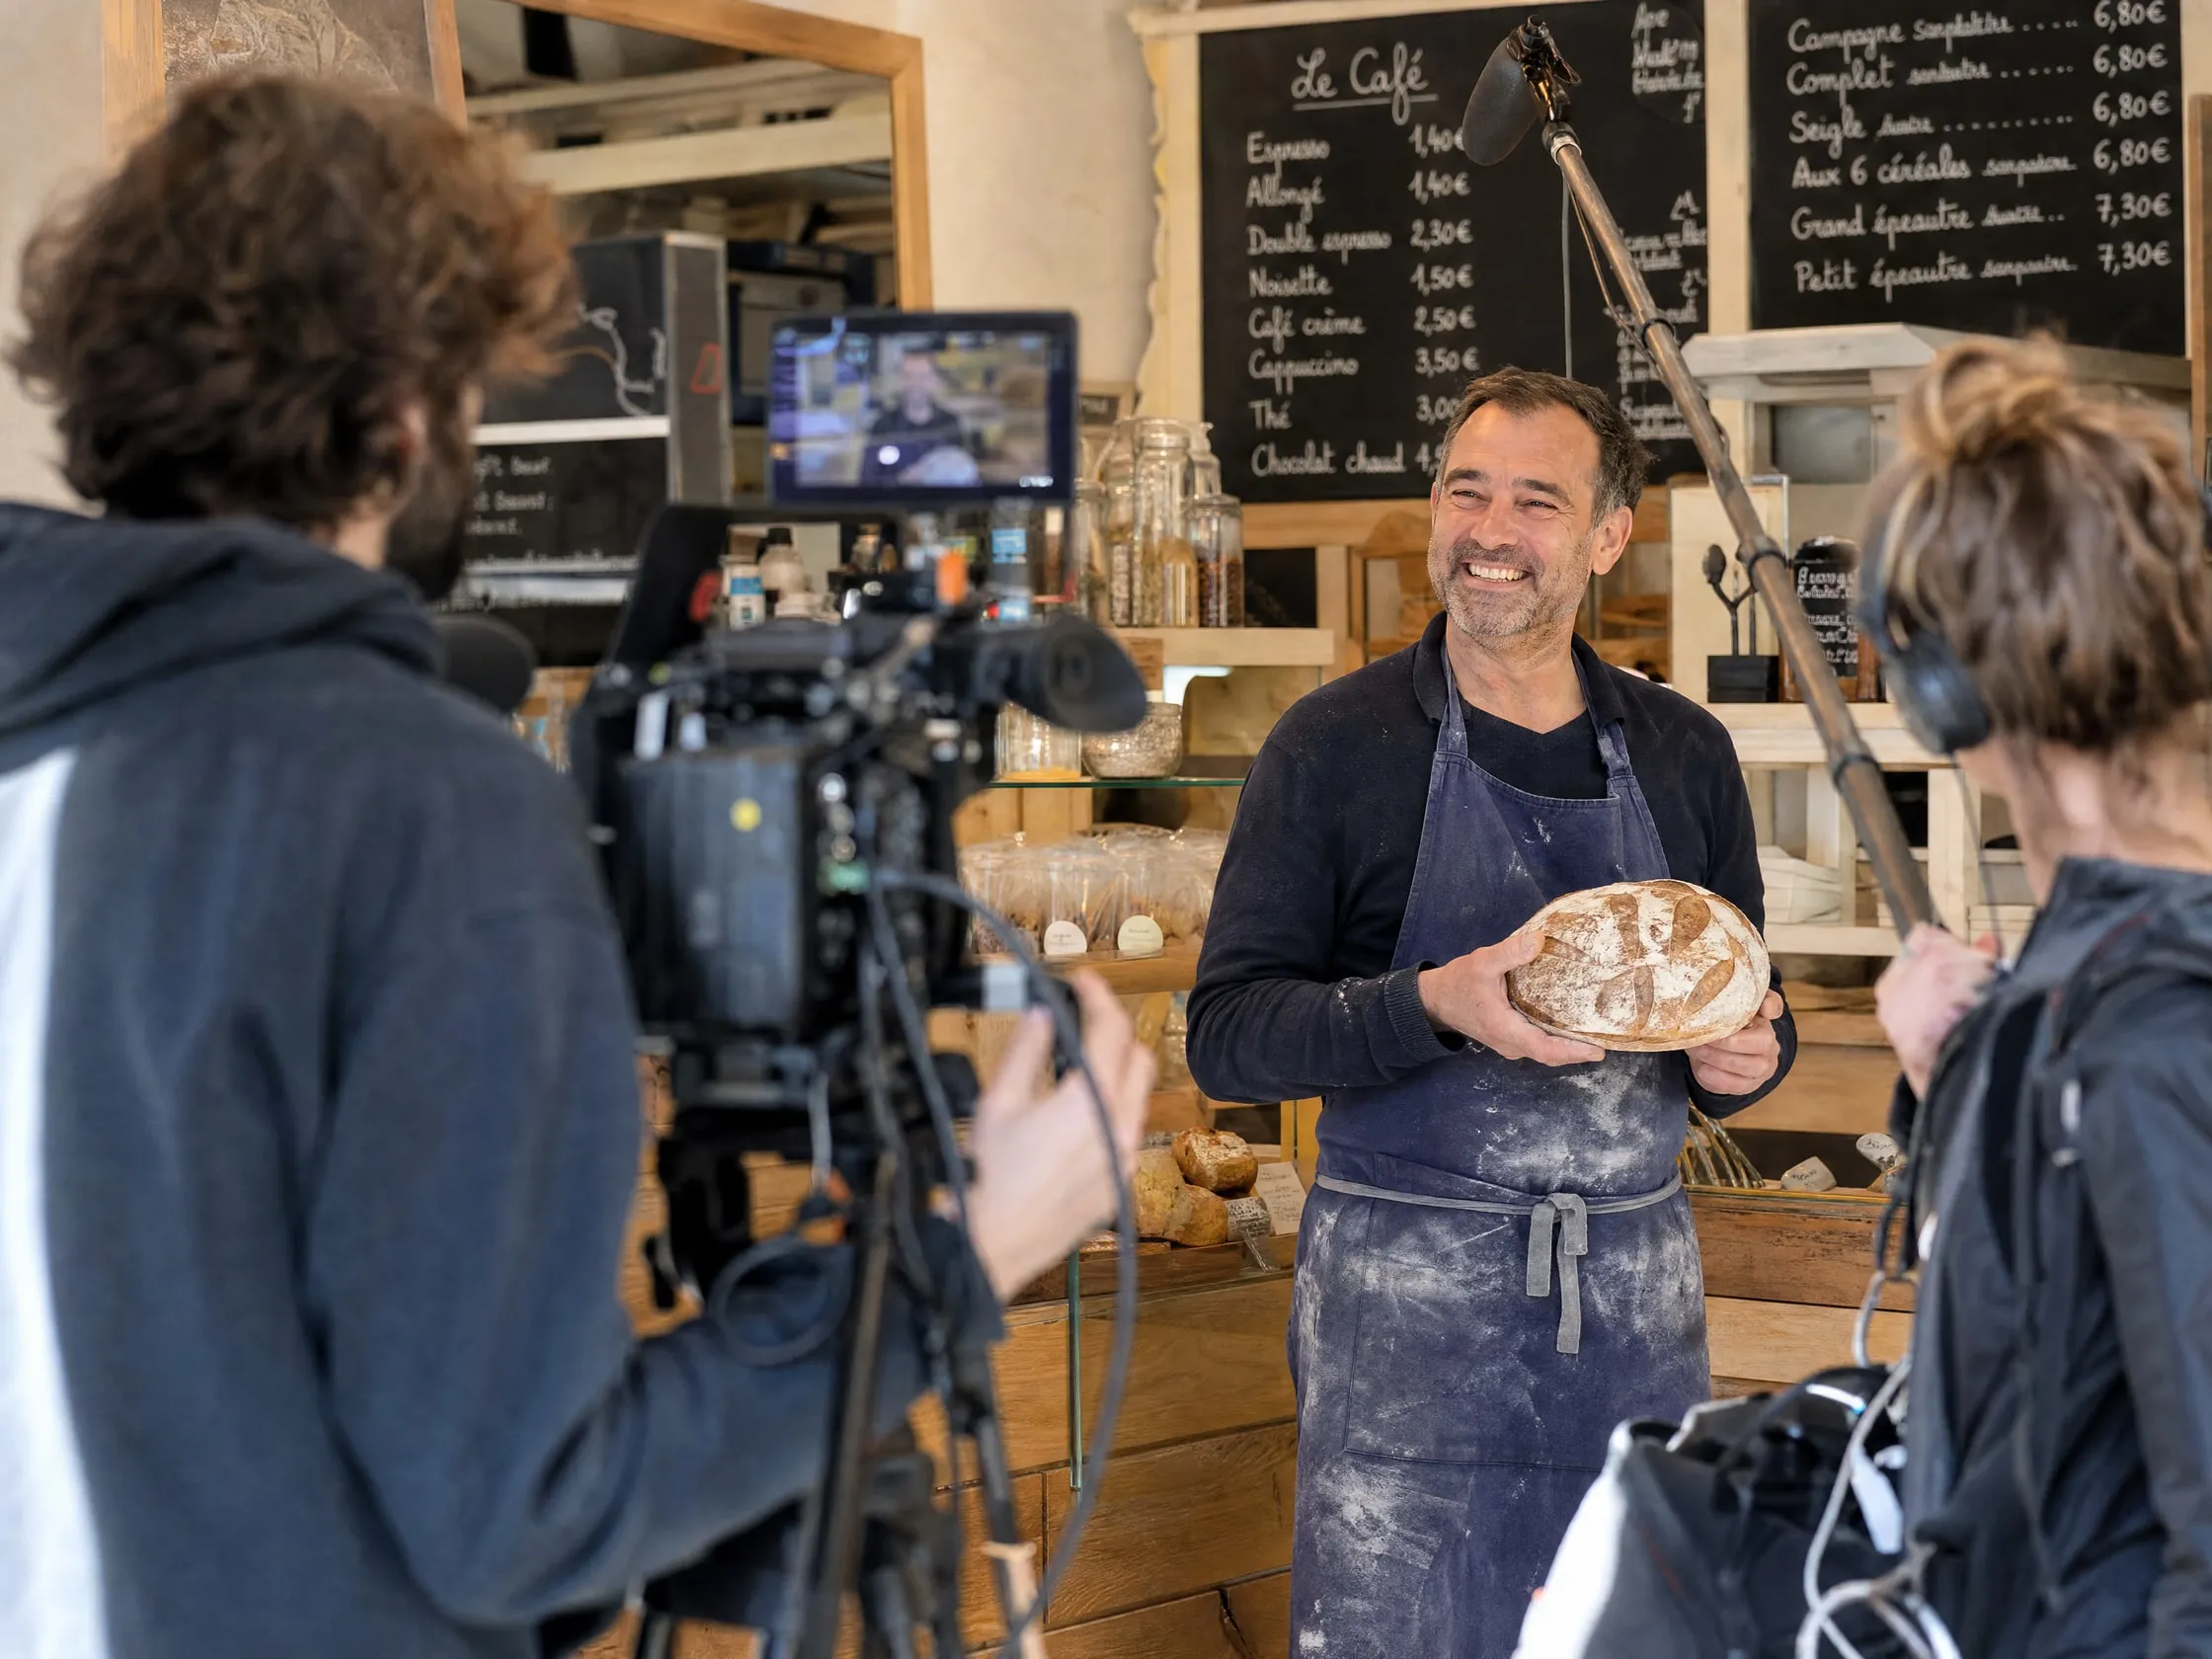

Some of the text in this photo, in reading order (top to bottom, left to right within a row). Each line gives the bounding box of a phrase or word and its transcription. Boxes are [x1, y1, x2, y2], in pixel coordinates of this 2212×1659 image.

[1787, 18, 1905, 64] Campagne
[2094, 0, 2168, 34] 6,80€
[1291, 41, 1429, 125] Le Café
[1785, 53, 1895, 108] Complet
[2093, 42, 2168, 78] 6,80€
[1788, 105, 1868, 159] Seigle
[2093, 89, 2171, 127] 6,80€
[1791, 156, 1842, 189] Aux
[1850, 154, 1868, 186] 6
[1877, 143, 1972, 184] céréales
[2094, 136, 2172, 176] 6,80€
[1246, 170, 1470, 224] Allongé 1,40€
[1790, 202, 1867, 240] Grand
[1871, 198, 1974, 251] épeautre
[2094, 192, 2172, 228] 7,30€
[1246, 220, 1317, 256] Double
[1410, 218, 1473, 252] 2,30€
[1410, 263, 1474, 296] 1,50€
[1793, 258, 1858, 292] Petit
[1868, 250, 1974, 303] épeautre
[2096, 240, 2172, 276] 7,30€
[1248, 305, 1296, 355] Café
[1413, 305, 1477, 338] 2,50€
[1415, 347, 1480, 378] 3,50€
[1248, 398, 1293, 430] Thé
[1250, 440, 1336, 477] Chocolat
[1345, 440, 1407, 474] chaud
